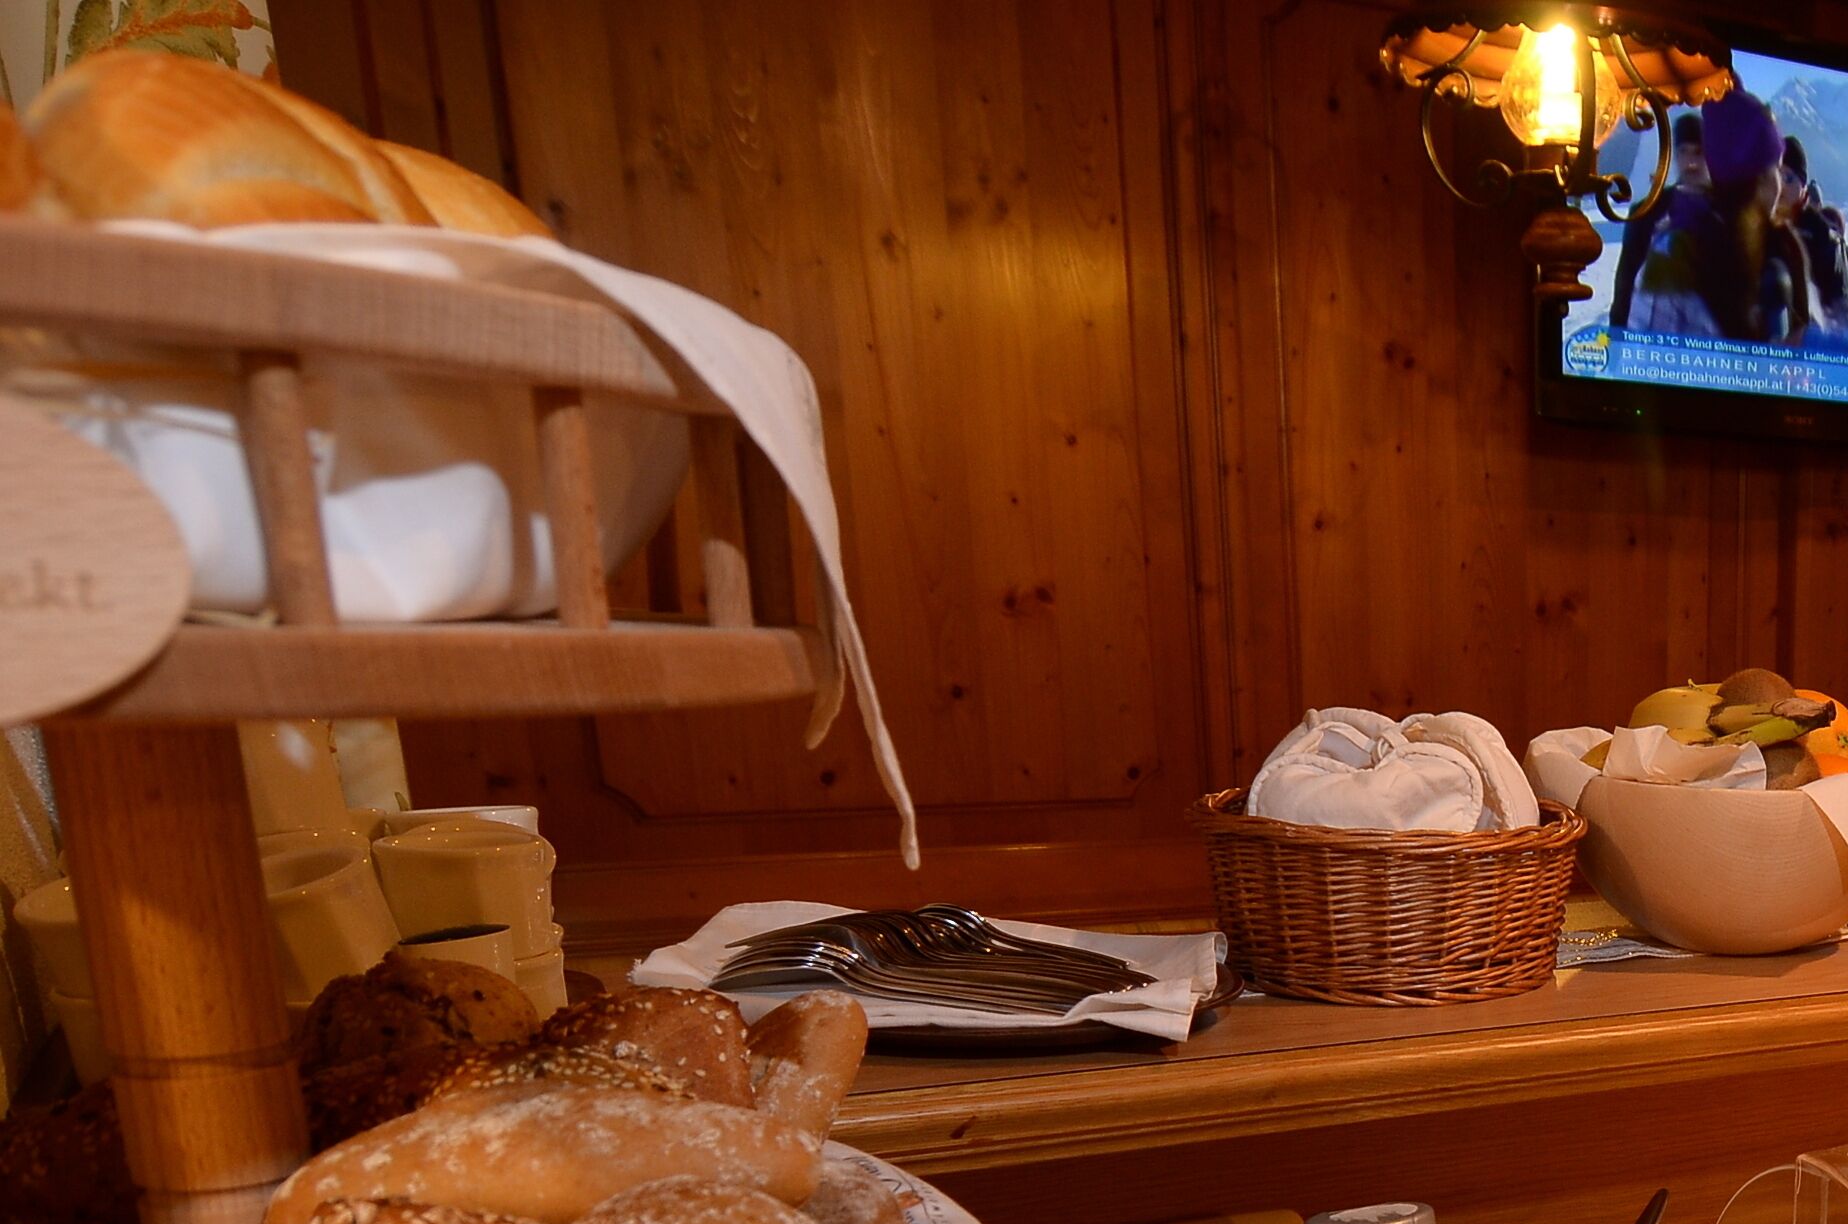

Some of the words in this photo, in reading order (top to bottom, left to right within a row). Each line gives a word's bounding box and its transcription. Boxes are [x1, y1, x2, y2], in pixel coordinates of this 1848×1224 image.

[1622, 330, 1654, 345] Temp:
[1666, 336, 1679, 347] °C
[1685, 337, 1712, 351] Wind
[1621, 348, 1758, 373] BERGBAHNEN
[1769, 362, 1827, 380] KAPPL
[1621, 364, 1784, 393] info@bergbahnenkappl.at
